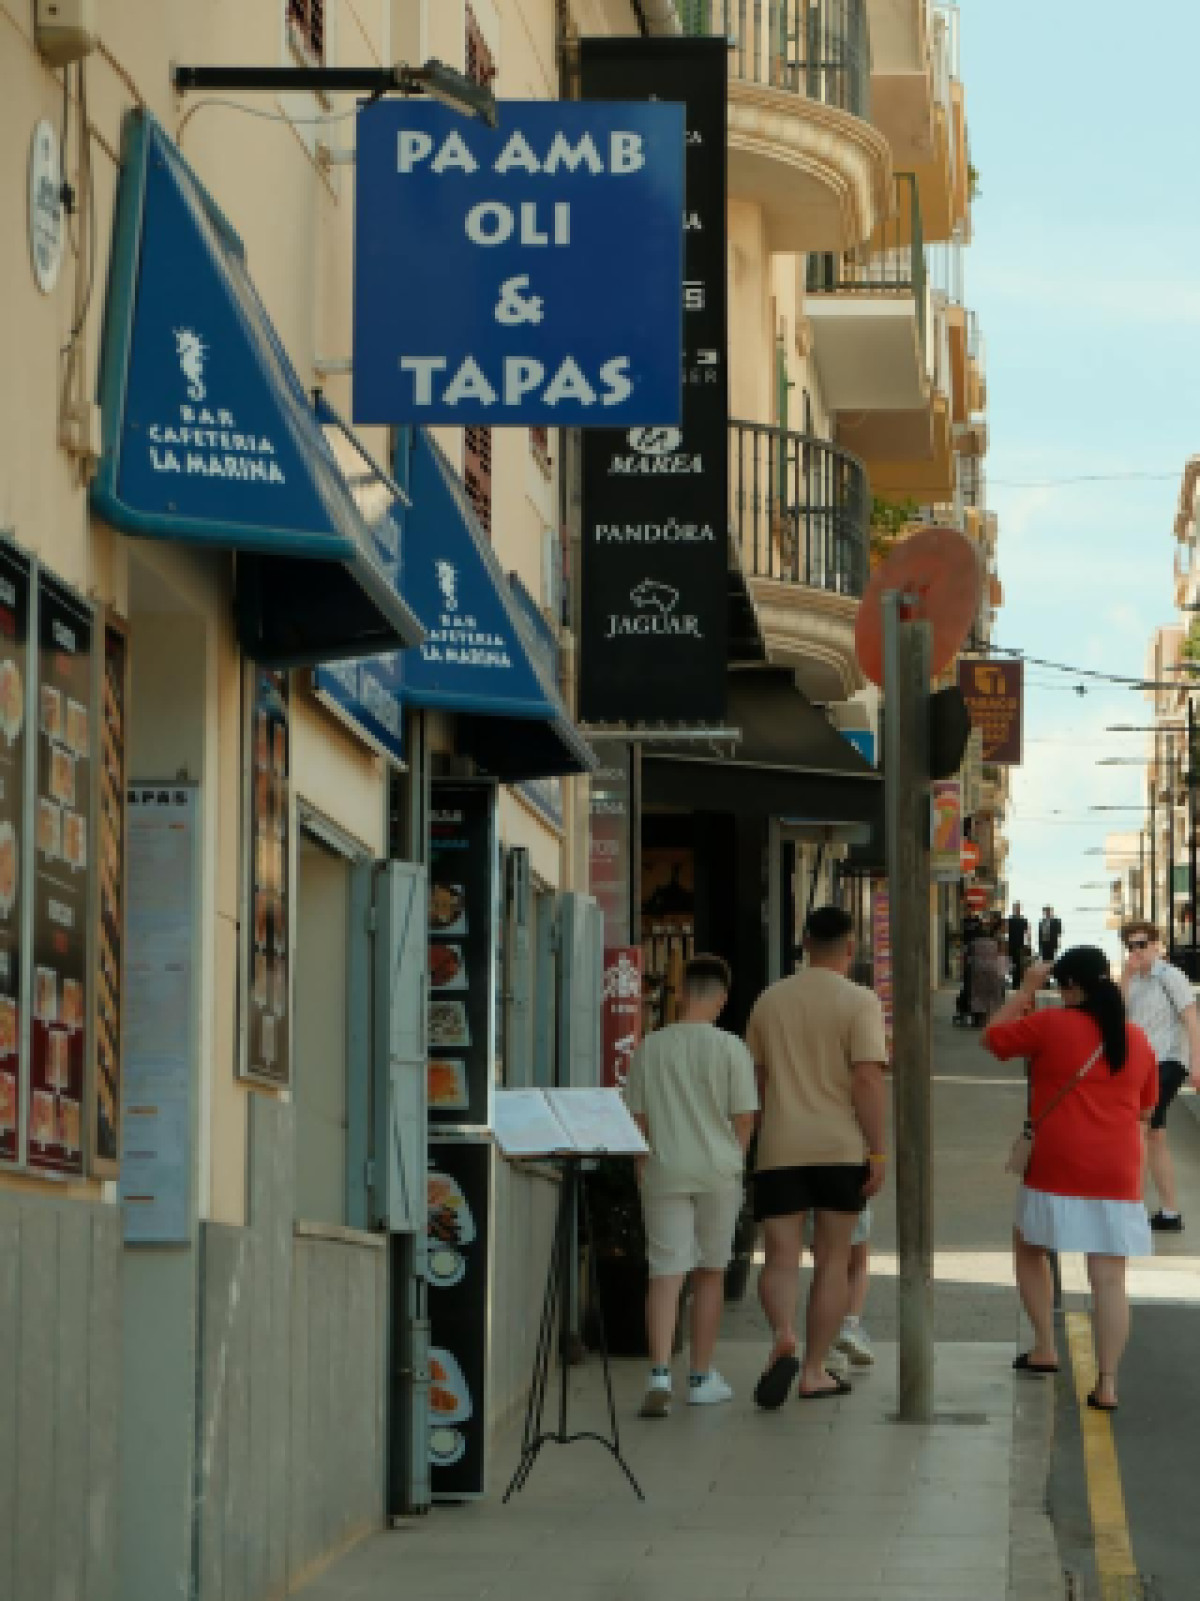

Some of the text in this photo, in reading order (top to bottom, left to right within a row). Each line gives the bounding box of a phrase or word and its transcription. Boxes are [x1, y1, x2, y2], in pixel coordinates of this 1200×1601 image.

[397, 130, 646, 175] PA AMB
[465, 201, 571, 247] OLI
[494, 273, 546, 328] &
[400, 356, 634, 406] TAPAS
[181, 405, 235, 427] BAR
[149, 424, 274, 454] CAFETERIA
[150, 446, 285, 484] LA MARINA
